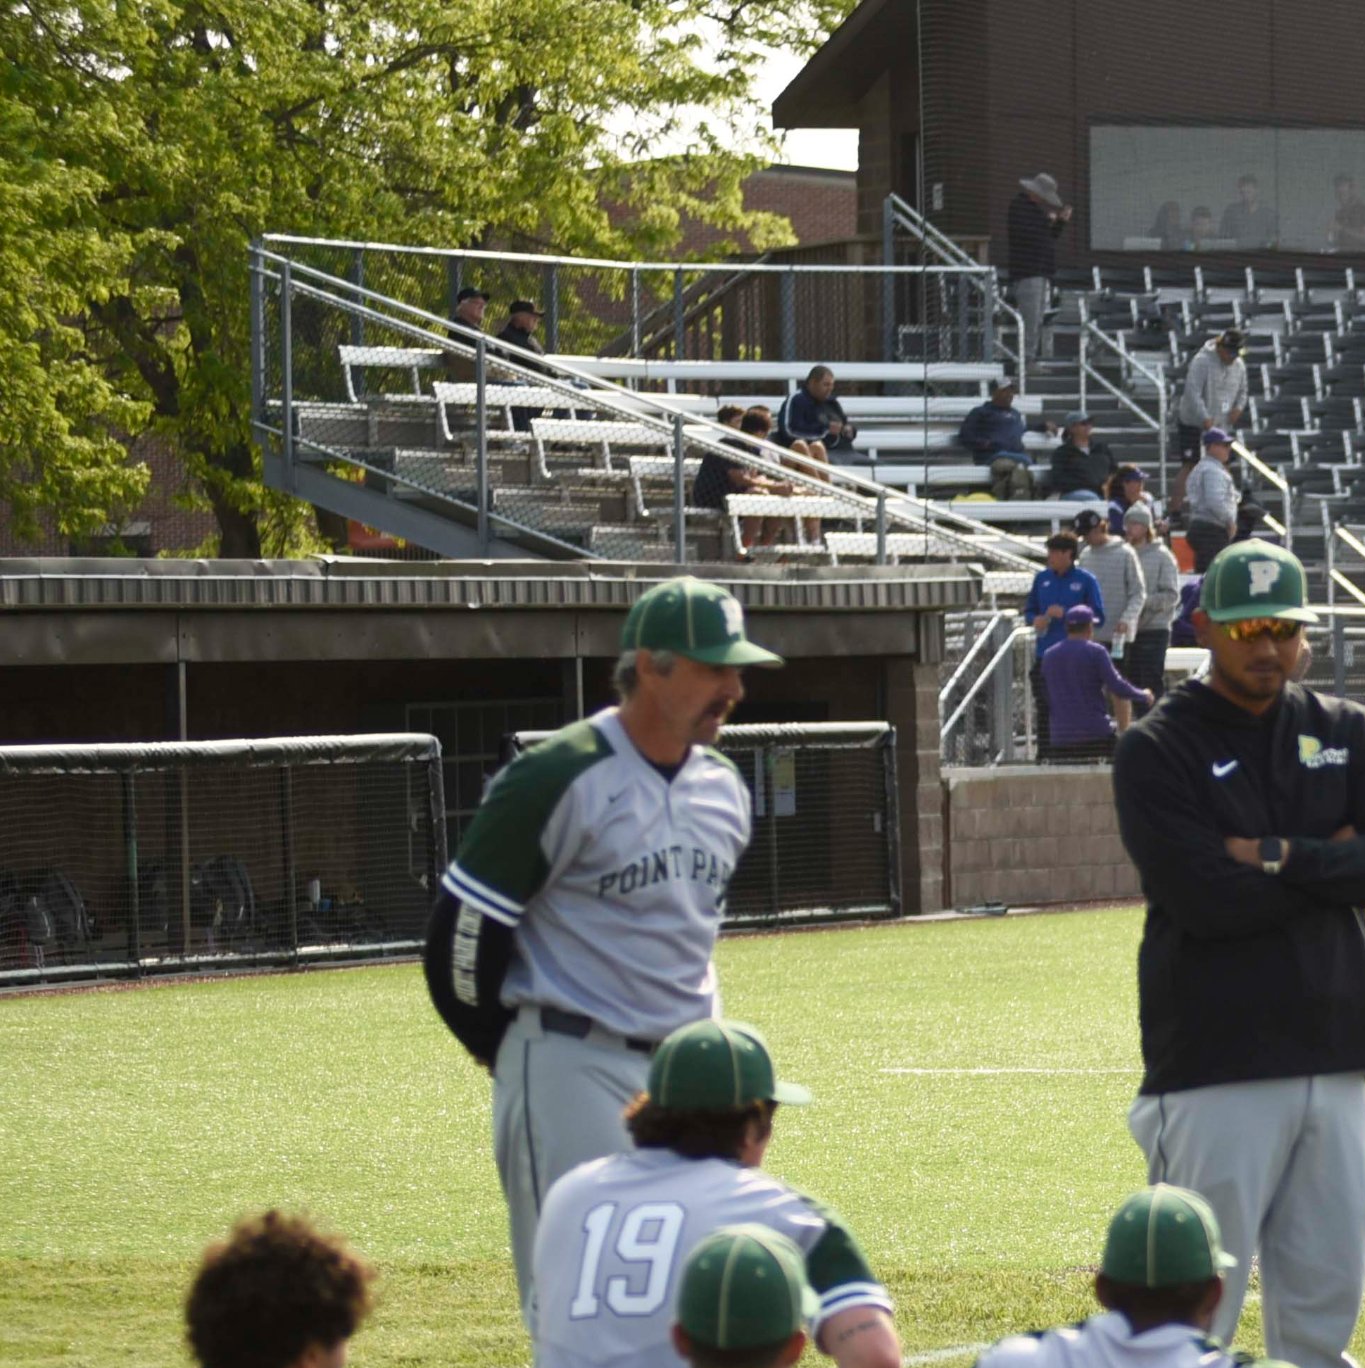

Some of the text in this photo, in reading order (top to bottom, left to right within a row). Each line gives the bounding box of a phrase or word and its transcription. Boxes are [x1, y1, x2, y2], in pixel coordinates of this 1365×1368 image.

[1248, 561, 1279, 596] P
[598, 845, 683, 900] POINT
[569, 1200, 685, 1321] 19
